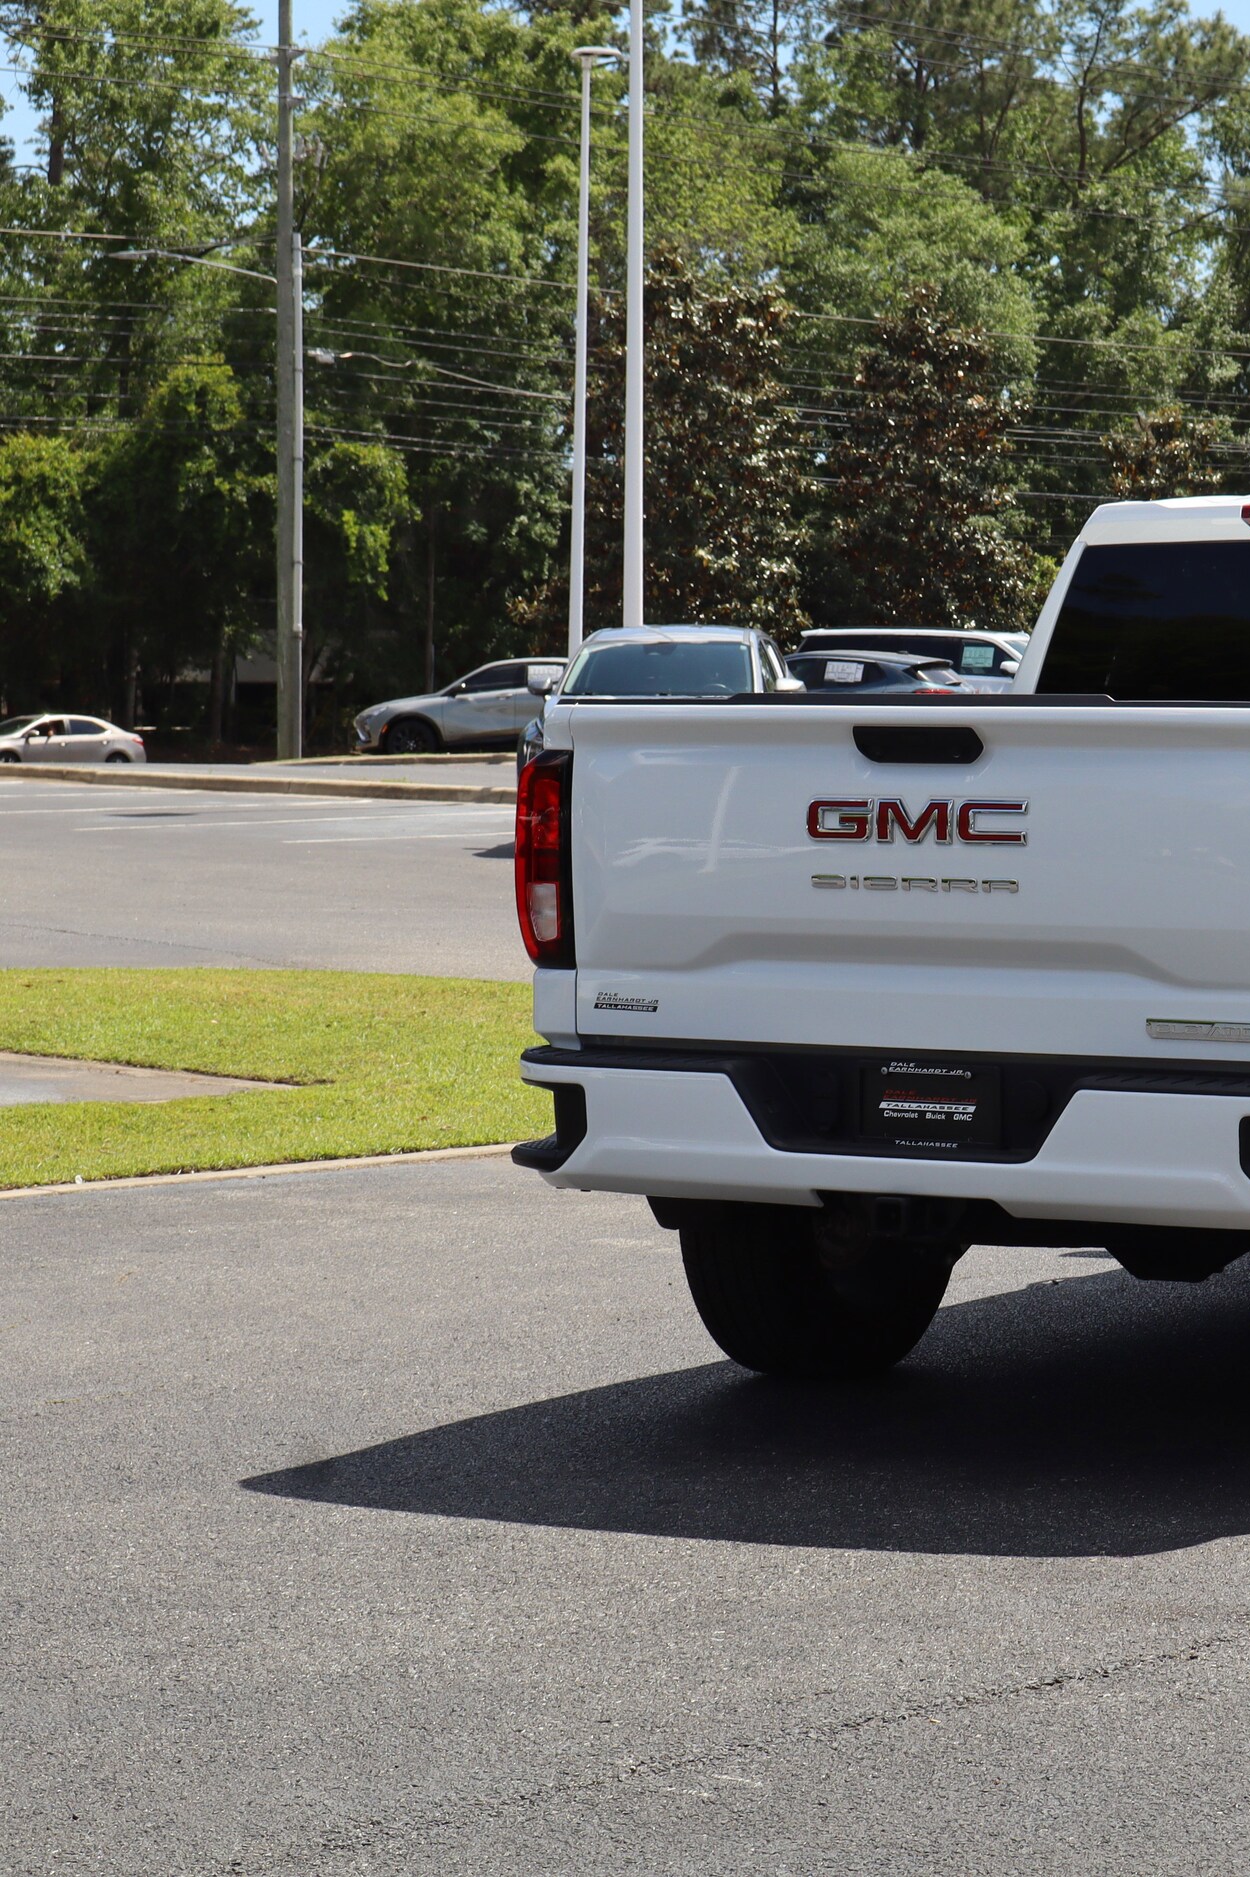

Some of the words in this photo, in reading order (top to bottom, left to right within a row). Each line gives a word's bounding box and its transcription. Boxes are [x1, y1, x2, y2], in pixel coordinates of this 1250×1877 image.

[806, 797, 1028, 846] GMC
[811, 874, 1019, 894] SIERRA
[597, 1003, 654, 1011] TALLAHASSEE
[886, 1103, 969, 1111] TALLAHASSEE
[884, 1110, 918, 1119] Chevrolet
[926, 1112, 946, 1120] Buick
[895, 1139, 958, 1148] TALLAHASSEE
